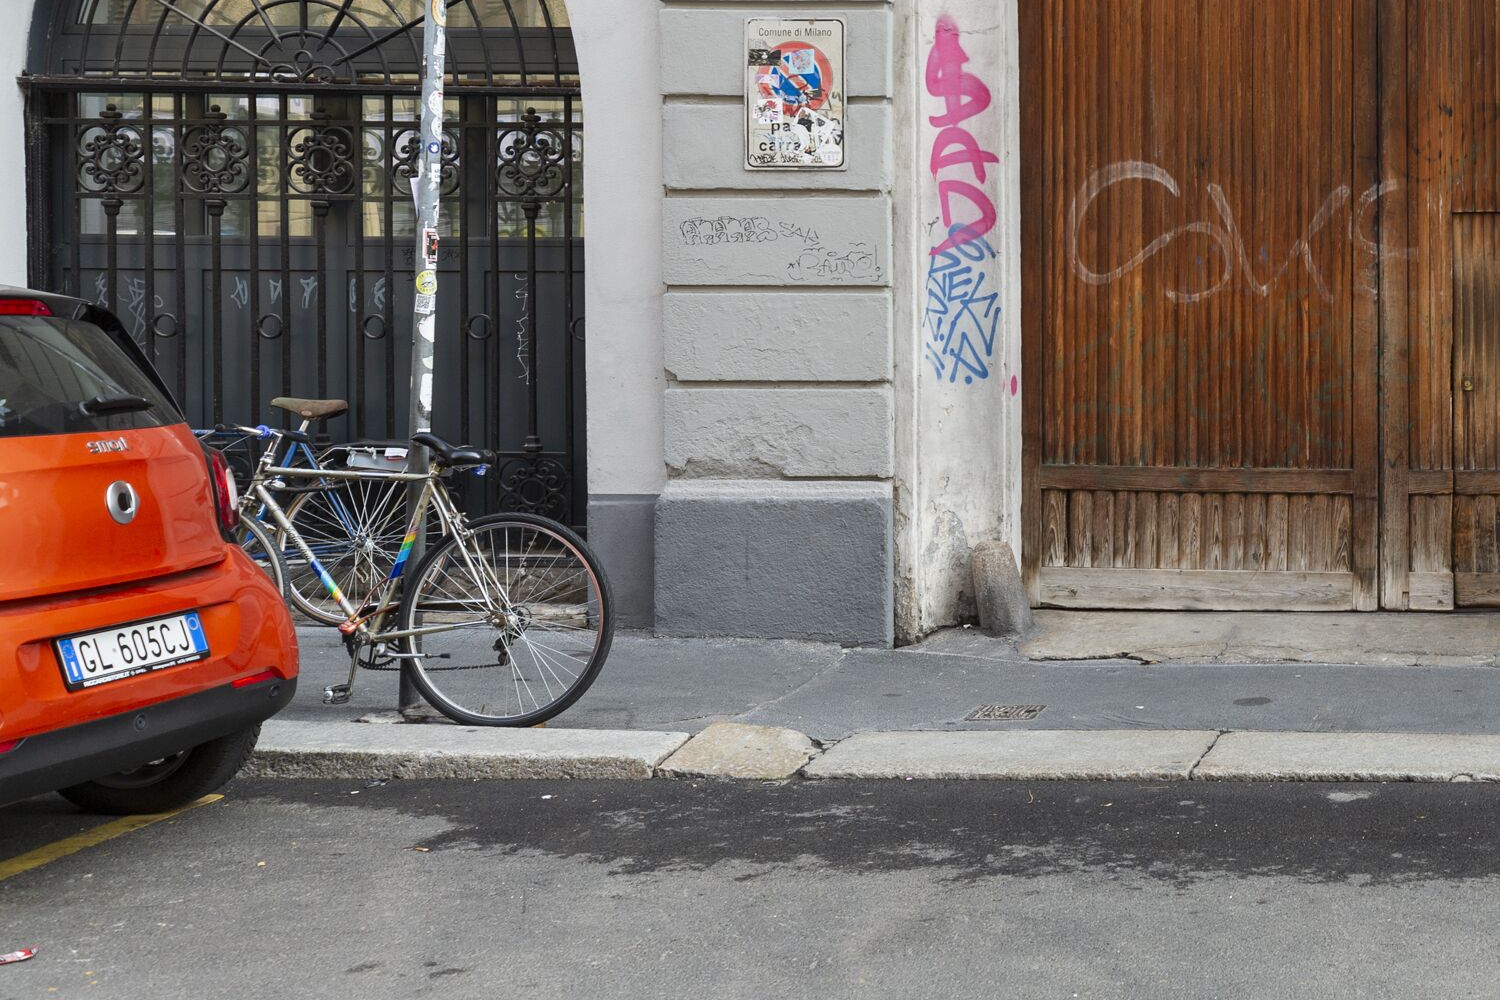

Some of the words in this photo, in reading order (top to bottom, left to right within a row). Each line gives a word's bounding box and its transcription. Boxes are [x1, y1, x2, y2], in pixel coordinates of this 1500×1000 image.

[758, 27, 792, 37] Comune
[793, 27, 802, 37] di
[804, 27, 832, 37] Milano
[86, 436, 129, 454] smart
[78, 638, 113, 673] GL
[116, 619, 190, 664] 605CJ
